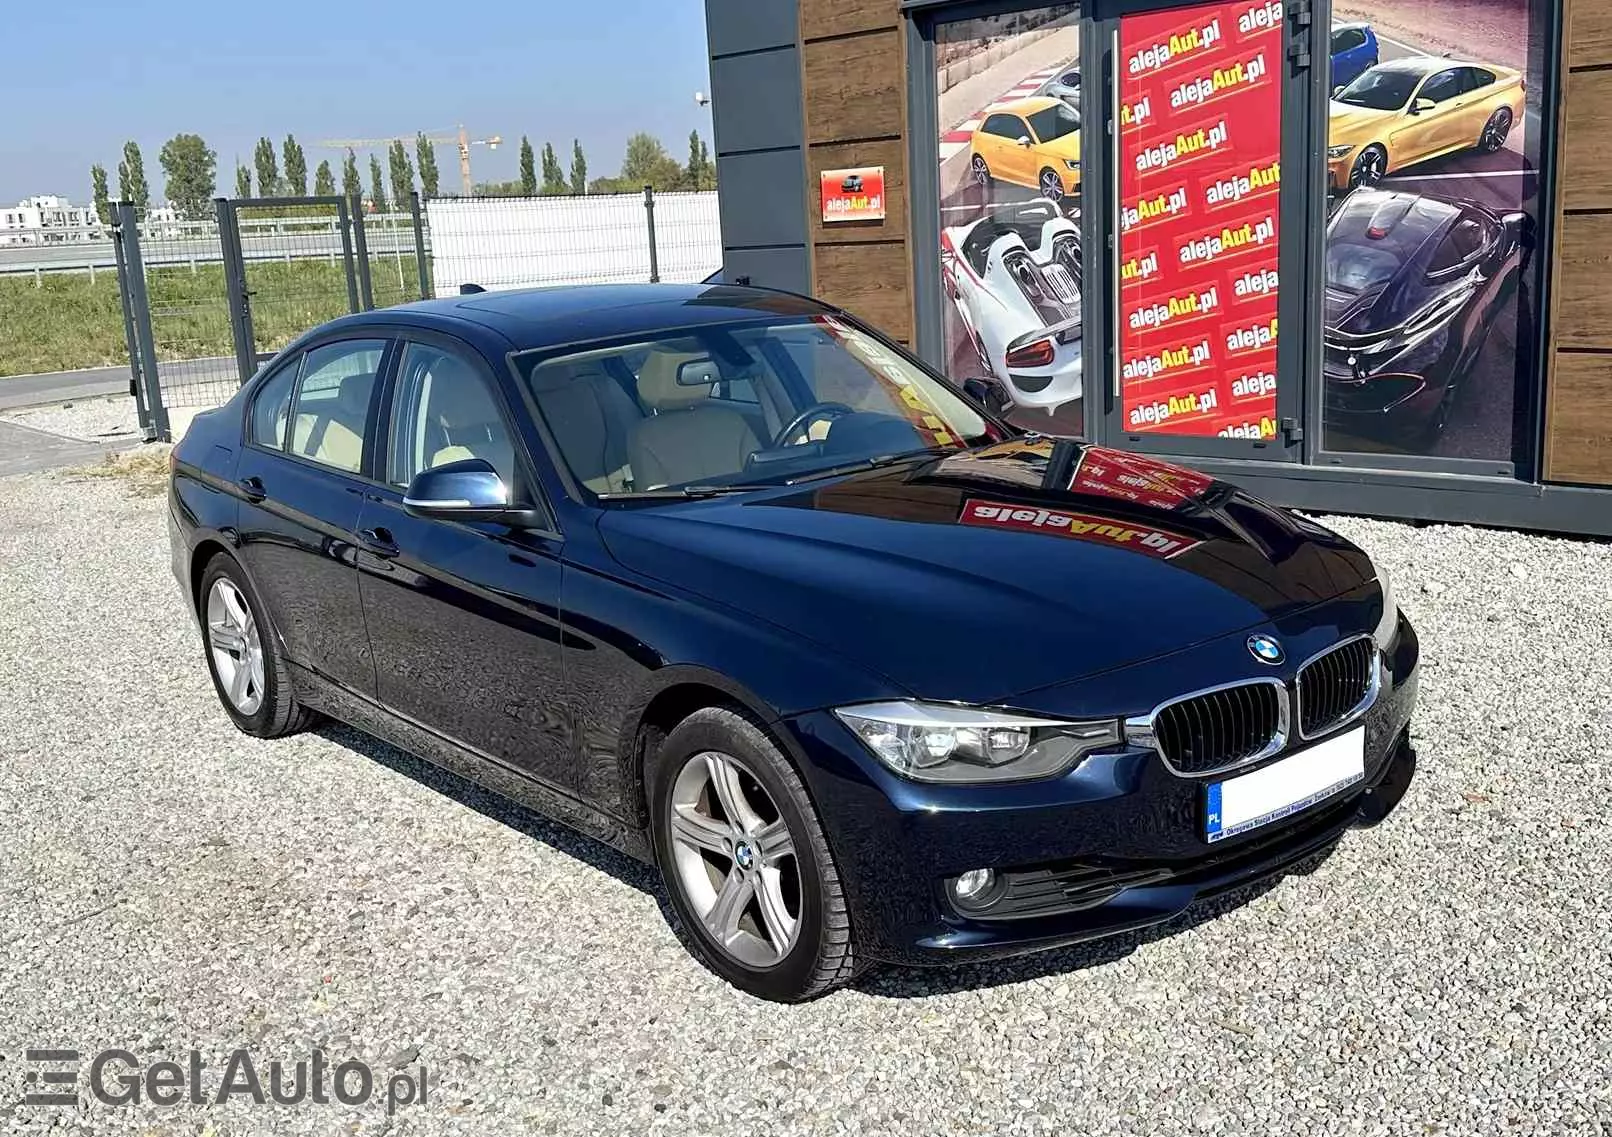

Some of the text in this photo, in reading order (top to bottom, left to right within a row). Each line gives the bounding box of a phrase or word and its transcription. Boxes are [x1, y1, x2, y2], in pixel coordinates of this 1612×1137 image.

[1128, 20, 1220, 73] alejaAut.pl
[1170, 54, 1265, 107] alejaAut.pl
[1135, 121, 1227, 171] alejaAut.pl
[826, 194, 880, 212] alejaAut.pl
[1180, 217, 1274, 262] alejaAut.pl
[1129, 287, 1218, 329] alejaAut.pl
[1122, 340, 1211, 379] alejaAut.pl
[1130, 388, 1218, 425] alejaAut.pl
[1209, 811, 1220, 825] PL
